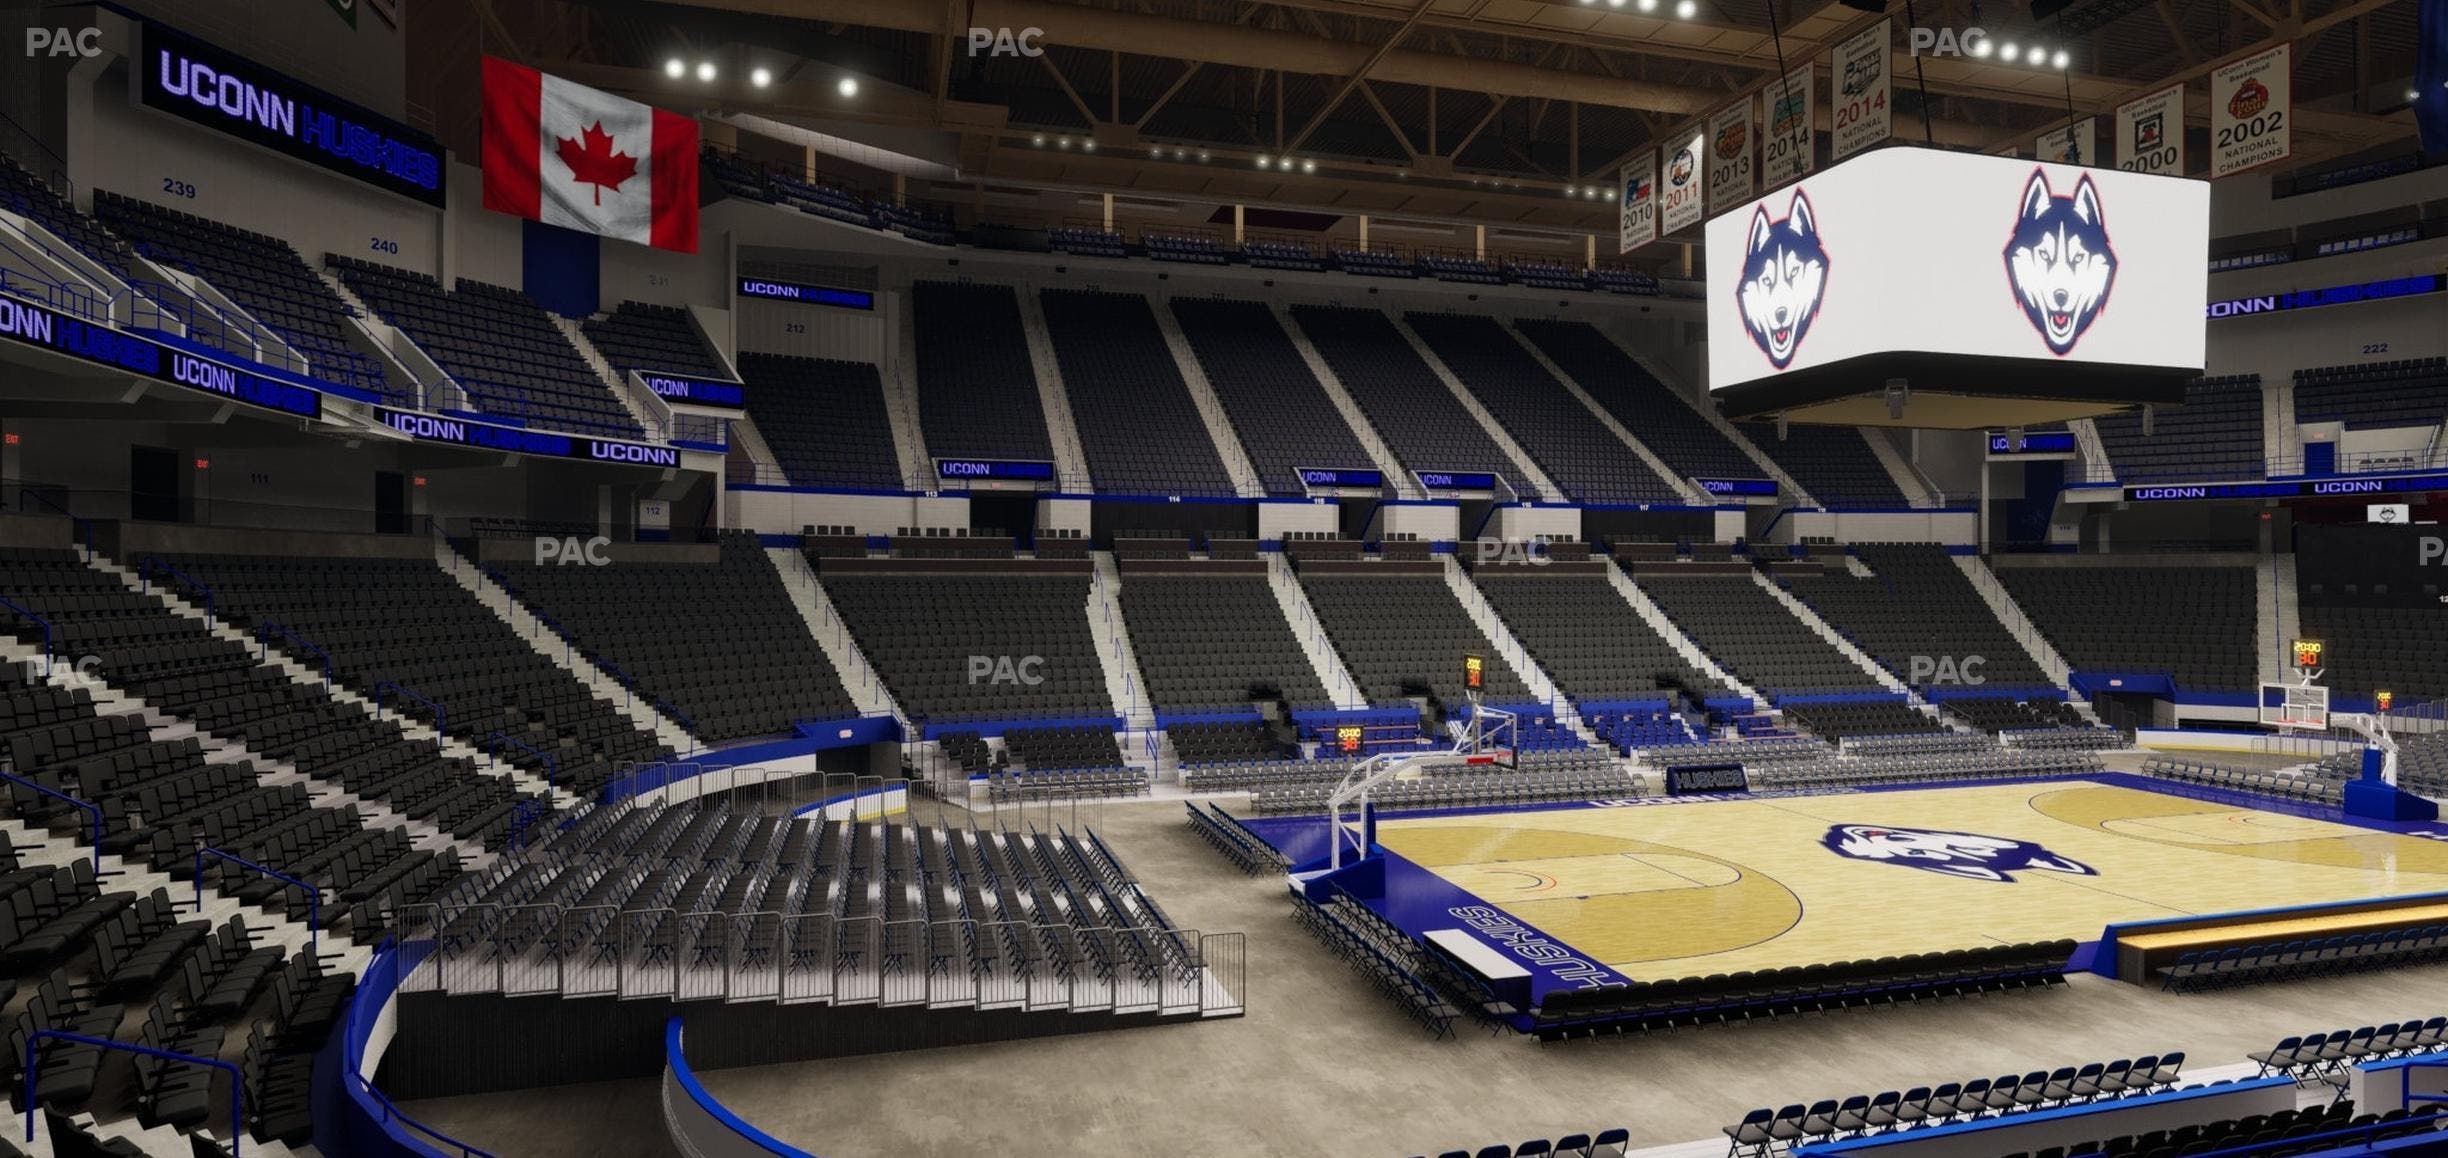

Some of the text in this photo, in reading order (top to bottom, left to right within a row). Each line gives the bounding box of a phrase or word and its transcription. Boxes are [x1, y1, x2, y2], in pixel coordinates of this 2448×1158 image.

[160, 48, 295, 138] UCONN
[1836, 88, 1887, 131] 2014
[1842, 116, 1883, 140] NATIONAL
[2217, 110, 2283, 149] 2002
[1767, 126, 1809, 162] 2014
[1838, 126, 1887, 155] CHAMPIONS
[2224, 136, 2279, 159] NATIONAL
[2219, 146, 2283, 174] CHAMPIONS
[1712, 155, 1750, 189] 2013
[163, 178, 196, 199] 239
[1665, 180, 1698, 211] 2011
[1622, 203, 1653, 230] 2010
[370, 237, 398, 255] 240
[743, 280, 800, 298] UCONN
[786, 323, 806, 334] 212
[2362, 342, 2389, 354] 222
[173, 353, 236, 395] UCONN
[646, 376, 689, 398] UCONN
[383, 411, 465, 442] UCONN
[591, 440, 675, 466] UCONN
[942, 462, 990, 475] UCONN
[1302, 471, 1337, 483] UCONN
[2135, 487, 2206, 500] UCONN
[2314, 480, 2383, 494] UCONN
[646, 506, 660, 515] 112
[2294, 641, 2321, 653] 20:00
[2299, 652, 2317, 665] 30
[1448, 905, 1628, 991] HUSKIES
